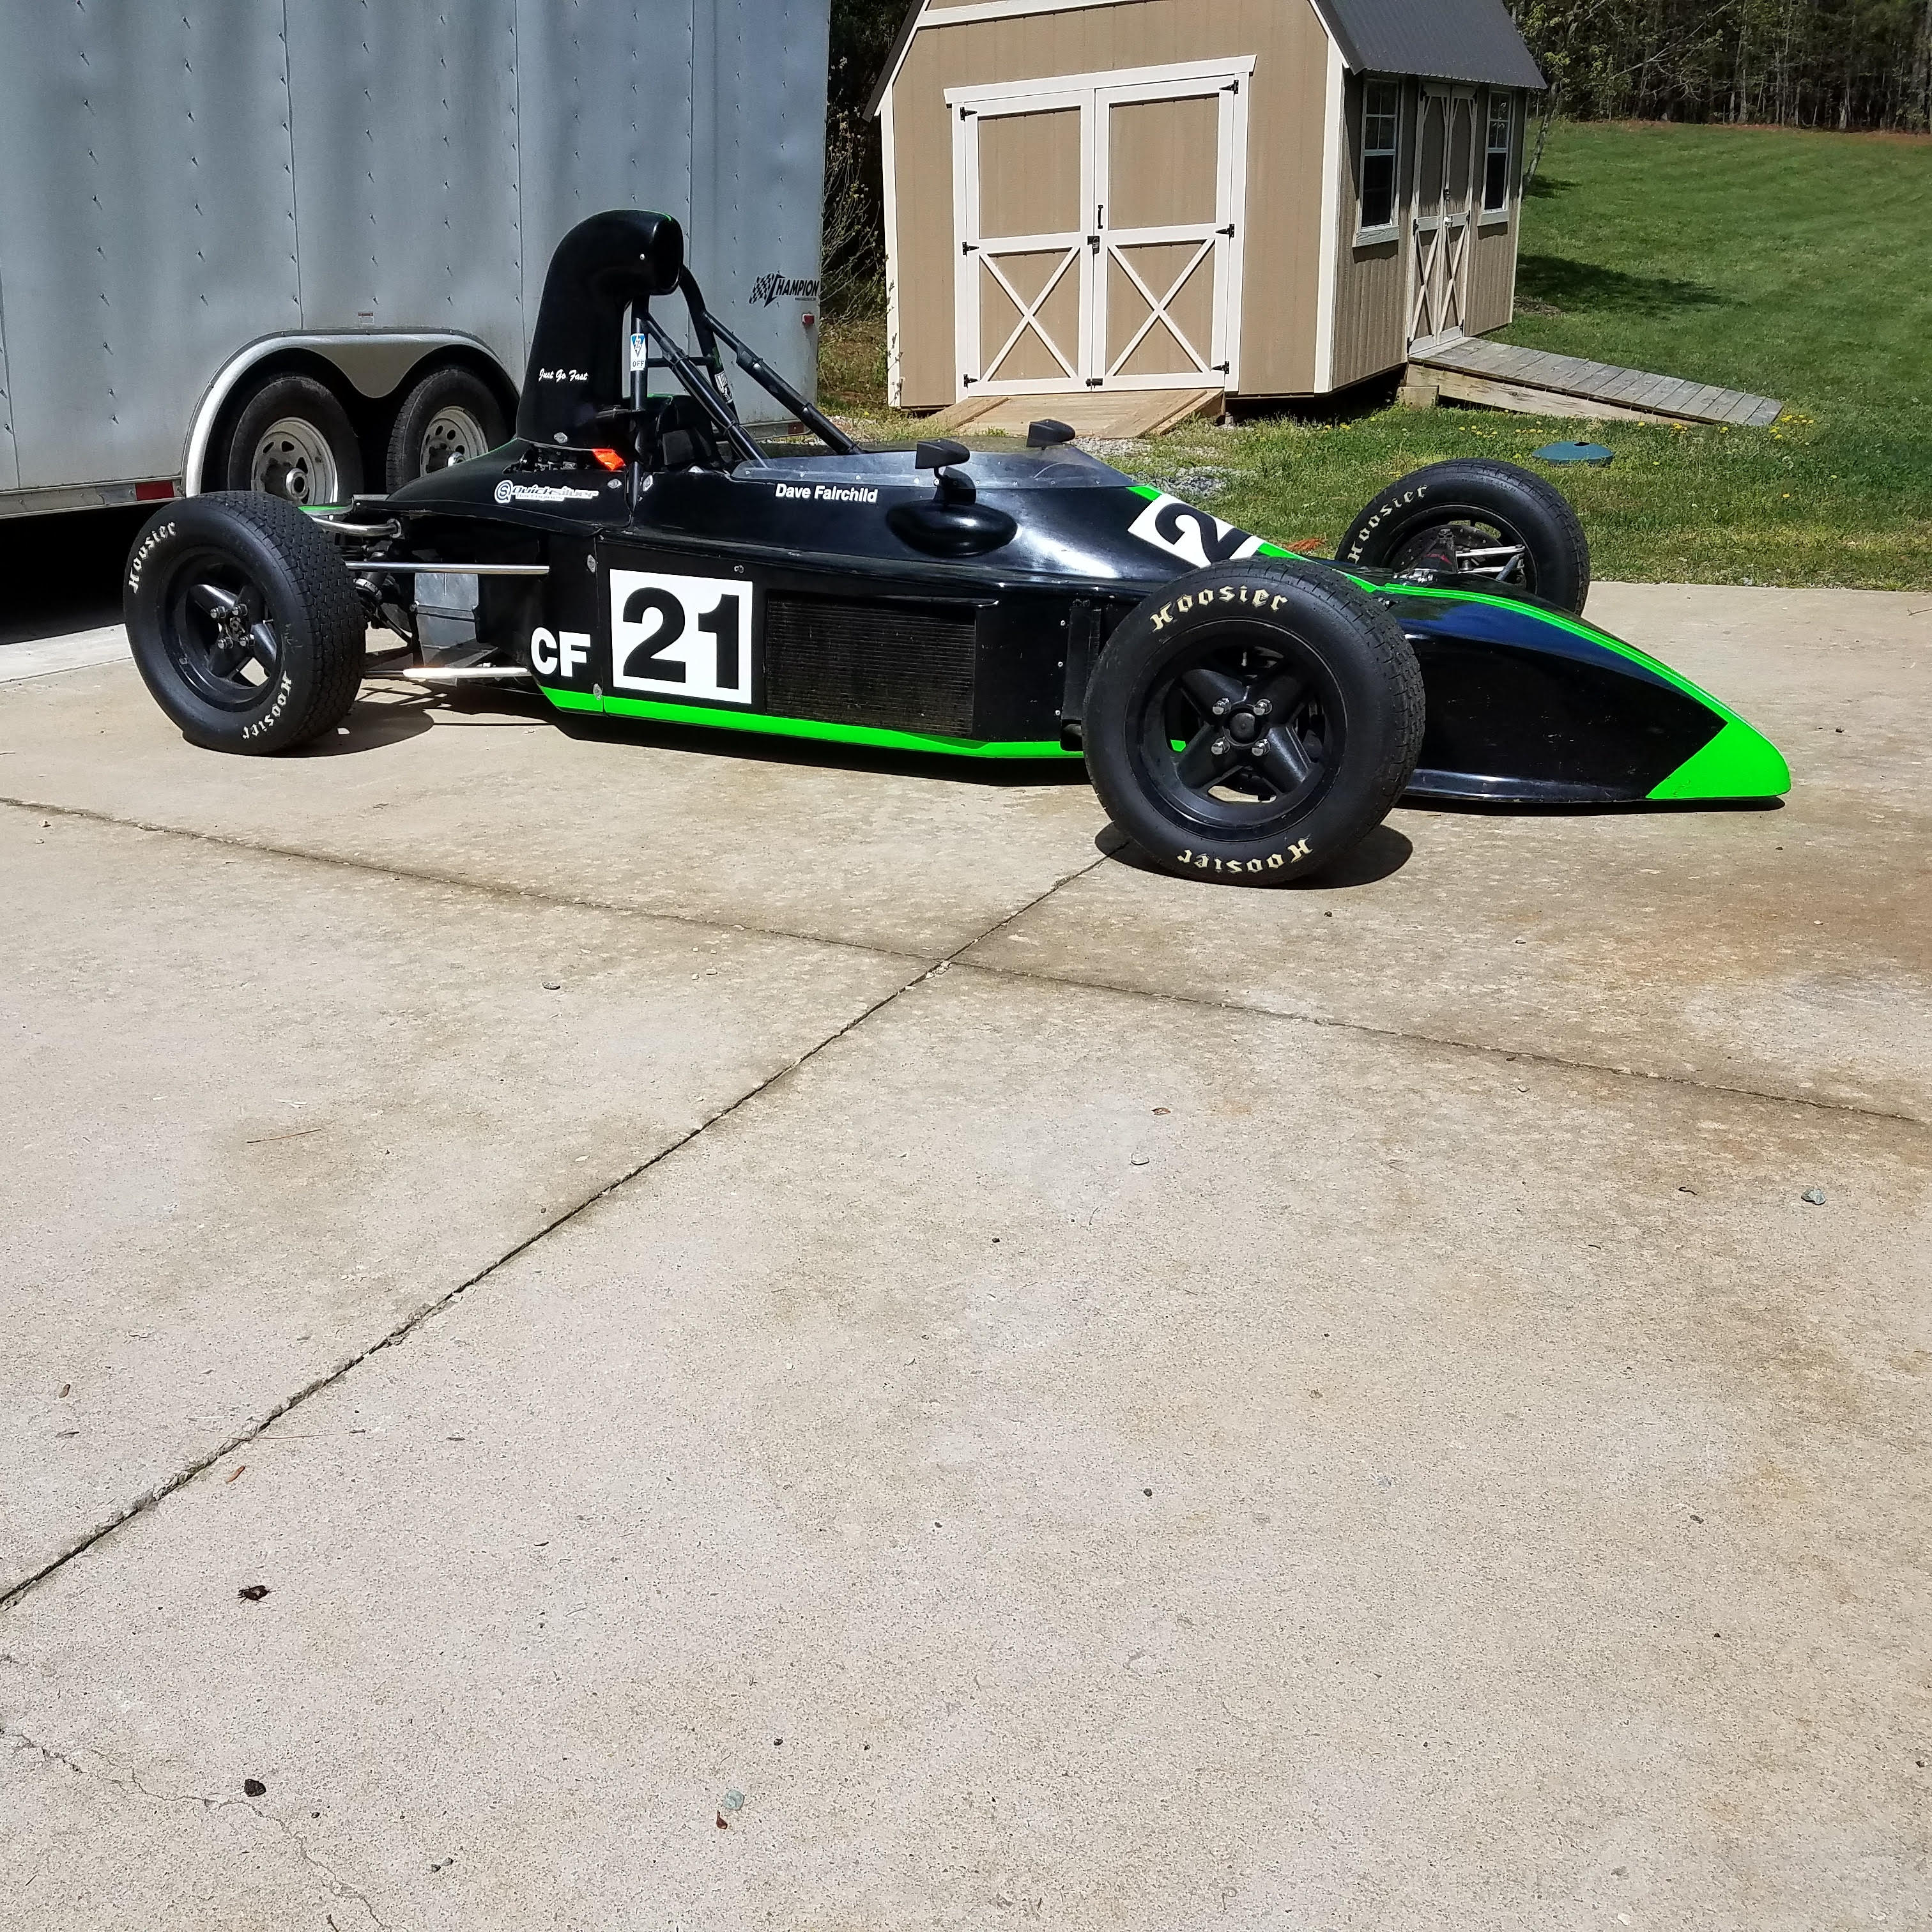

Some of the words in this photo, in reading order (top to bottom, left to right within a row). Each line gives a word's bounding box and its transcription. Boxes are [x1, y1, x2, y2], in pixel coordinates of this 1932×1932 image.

[764, 273, 820, 307] CHAMPION
[539, 367, 554, 382] Just
[555, 369, 567, 383] Go
[569, 369, 588, 382] Fast
[775, 483, 811, 499] Dave
[814, 485, 878, 503] Fairchild
[1347, 484, 1428, 564] Hoosier
[128, 521, 176, 594] Hoosier
[1149, 585, 1288, 632] Hoosier
[531, 627, 591, 677] CF
[622, 586, 740, 690] 21
[242, 670, 292, 739] Hoosier
[1177, 834, 1314, 873] Hoosier
